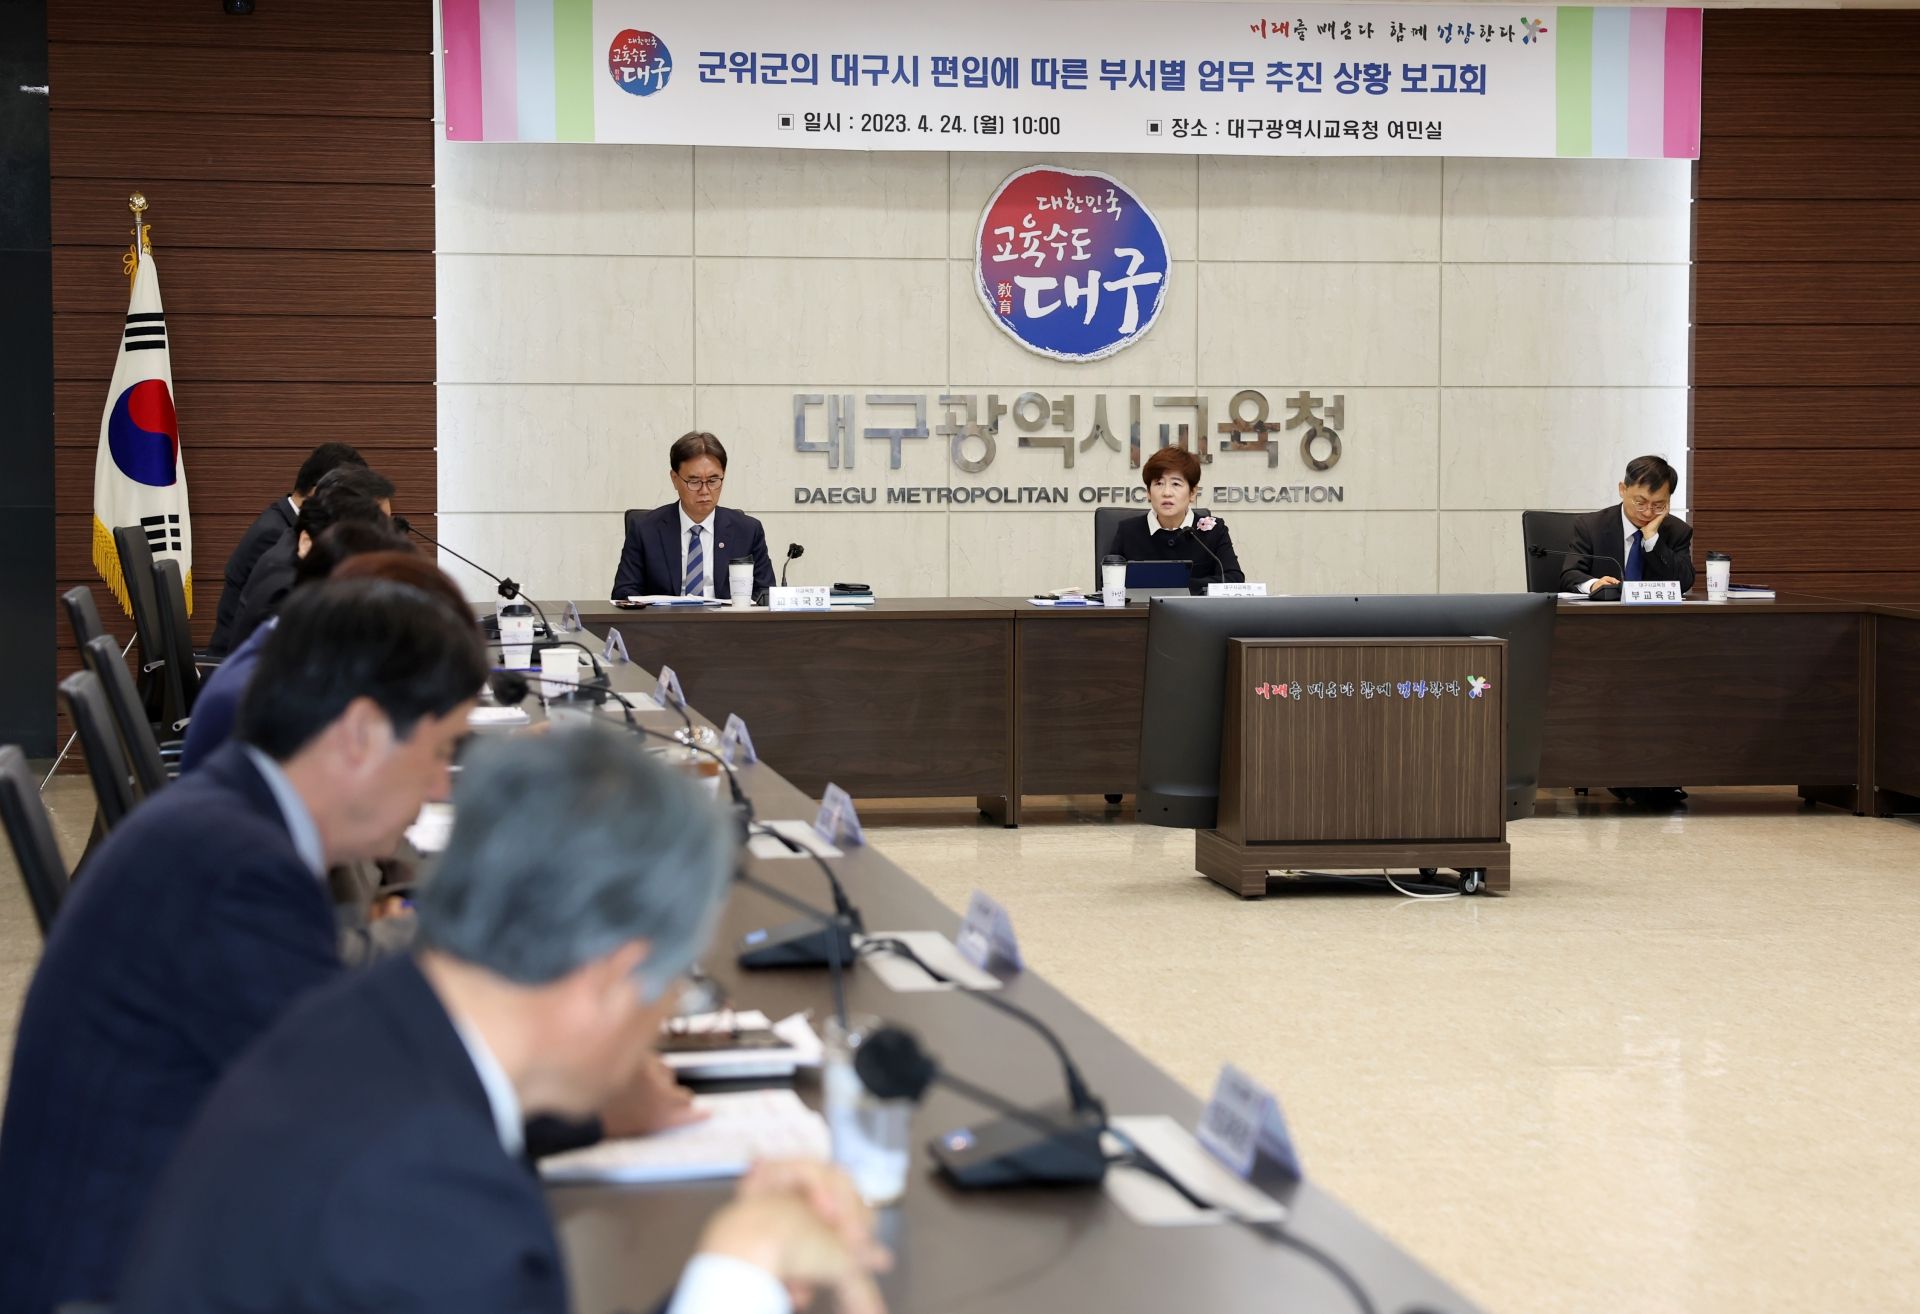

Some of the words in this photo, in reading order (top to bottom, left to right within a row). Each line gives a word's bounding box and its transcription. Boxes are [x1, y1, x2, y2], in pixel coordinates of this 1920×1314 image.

[627, 35, 657, 48] 대한민국
[1250, 18, 1308, 41] 미래를
[1316, 20, 1375, 40] 배운다
[1390, 21, 1428, 43] 함께
[1437, 22, 1516, 44] 성장한다
[612, 44, 647, 64] 교육수도
[620, 57, 671, 90] 대구
[698, 51, 818, 86] 군위군의
[831, 54, 919, 87] 대구시
[931, 55, 1019, 89] 편입에
[1031, 57, 1088, 90] 따른
[1099, 59, 1186, 92] 부서별
[1198, 60, 1255, 92] 업무
[1266, 61, 1322, 94] 추진
[1334, 62, 1391, 95] 상황
[1401, 63, 1486, 95] 보고회
[804, 112, 841, 132] 일시
[861, 113, 911, 133] 2023.
[918, 114, 933, 132] 4.
[940, 115, 967, 133] 24.
[1012, 116, 1060, 135] 10:00
[1171, 118, 1207, 138] 장소
[1228, 118, 1379, 140] 대구광역시교육청
[1387, 120, 1442, 140] 여민실
[1036, 188, 1122, 221] 대한민국
[992, 213, 1092, 268] 교육수도
[997, 282, 1013, 315] 教育
[1014, 247, 1163, 334] 대구
[793, 389, 1345, 474] 대구광역시교육청
[794, 487, 877, 504] DAEGU
[887, 487, 1068, 504] METROPOLITAN
[1079, 486, 1148, 503] OFFIC
[1213, 486, 1344, 503] EDUCATION
[1631, 590, 1676, 600] 부교육감
[1255, 681, 1302, 700] 미래를
[1307, 681, 1354, 699] 배운다
